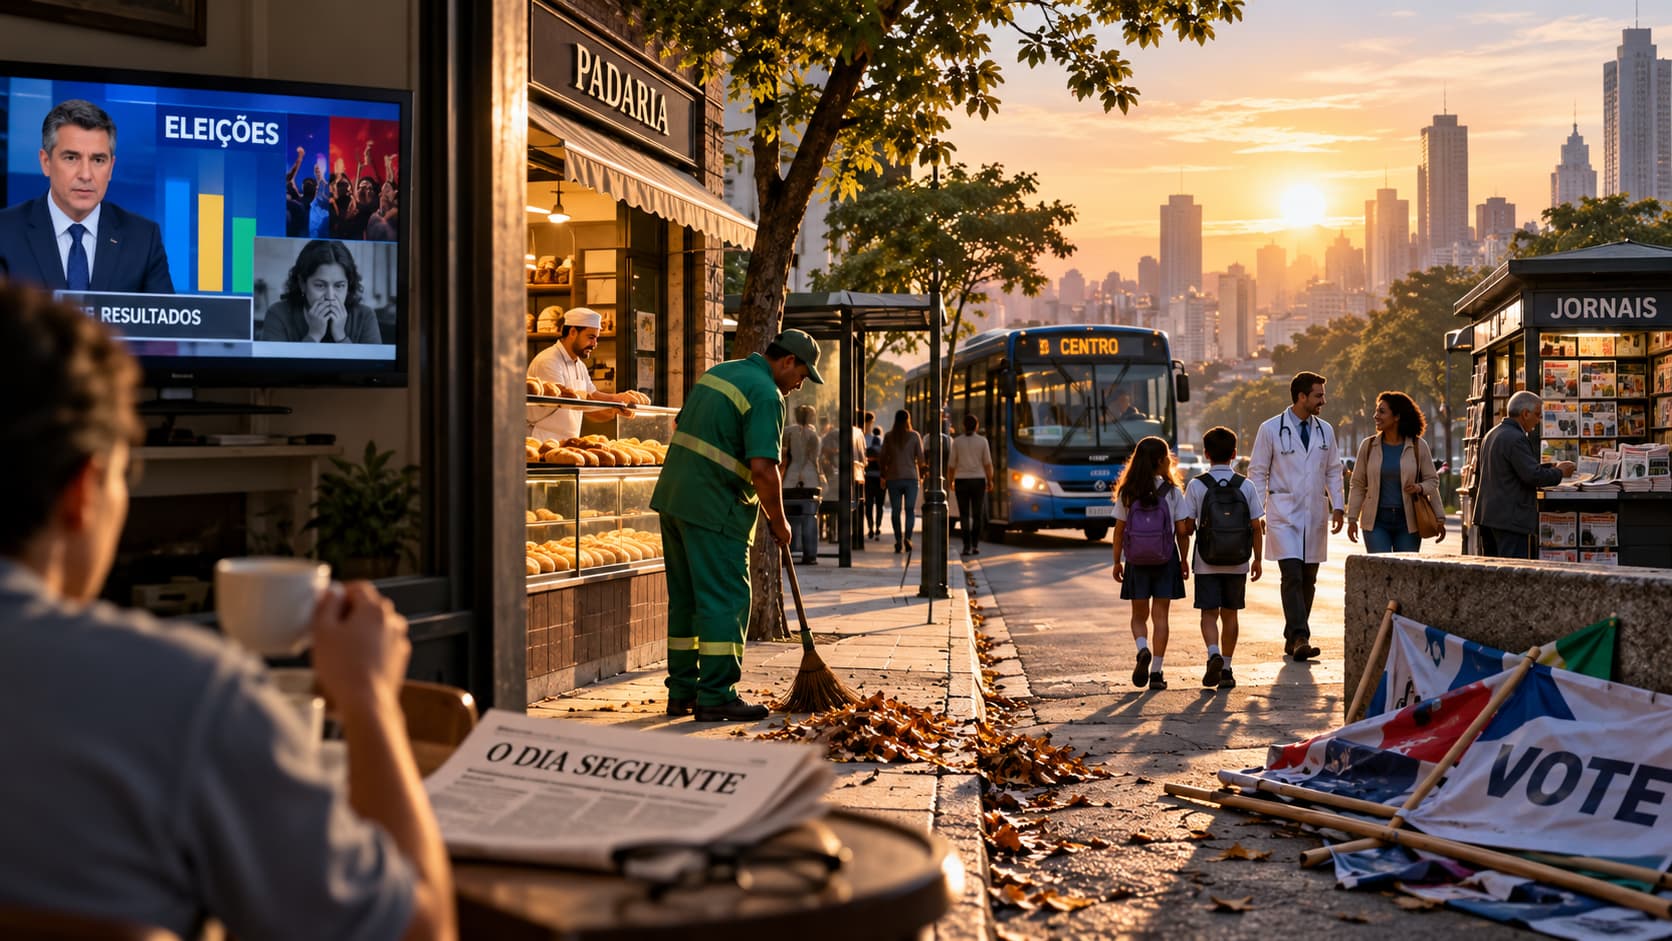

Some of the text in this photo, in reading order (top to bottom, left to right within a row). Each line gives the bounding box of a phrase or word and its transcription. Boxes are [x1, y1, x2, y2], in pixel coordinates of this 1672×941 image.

[575, 43, 670, 136] PADARIA
[165, 115, 279, 147] ELEIÇÕES
[101, 307, 201, 325] RESULTADOS
[1550, 297, 1657, 319] JORNAIS
[1060, 337, 1119, 355] CENTRO
[486, 742, 747, 795] O DIA SEGUINTE
[1487, 744, 1672, 827] VOTE
